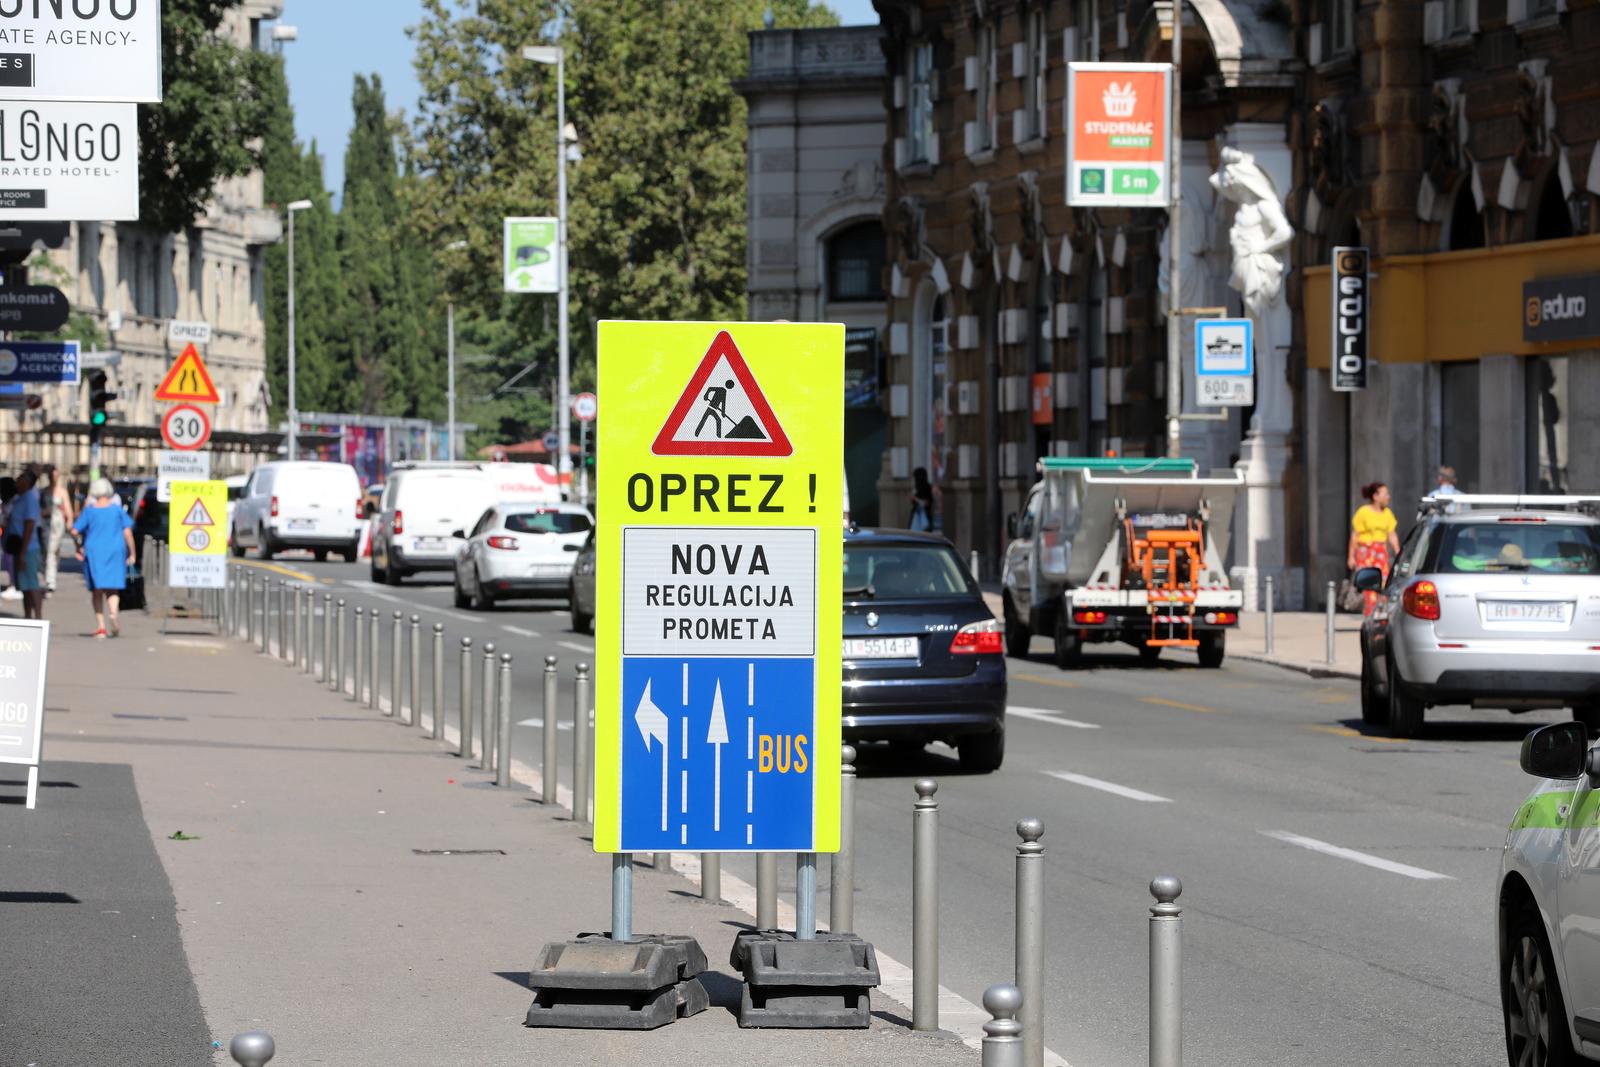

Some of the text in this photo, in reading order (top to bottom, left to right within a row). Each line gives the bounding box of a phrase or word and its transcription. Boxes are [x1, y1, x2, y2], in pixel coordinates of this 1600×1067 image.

[1085, 121, 1154, 135] STUDENAC
[1542, 293, 1586, 321] eduro
[21, 363, 75, 374] AGENCIJA
[1204, 380, 1229, 394] 600
[173, 416, 200, 438] 30
[627, 472, 817, 513] OPREZ !
[190, 533, 207, 547] 30
[671, 544, 770, 575] NOVA
[646, 585, 794, 607] REGULACIJA
[663, 618, 777, 640] PROMETA
[758, 734, 808, 774] BUS
